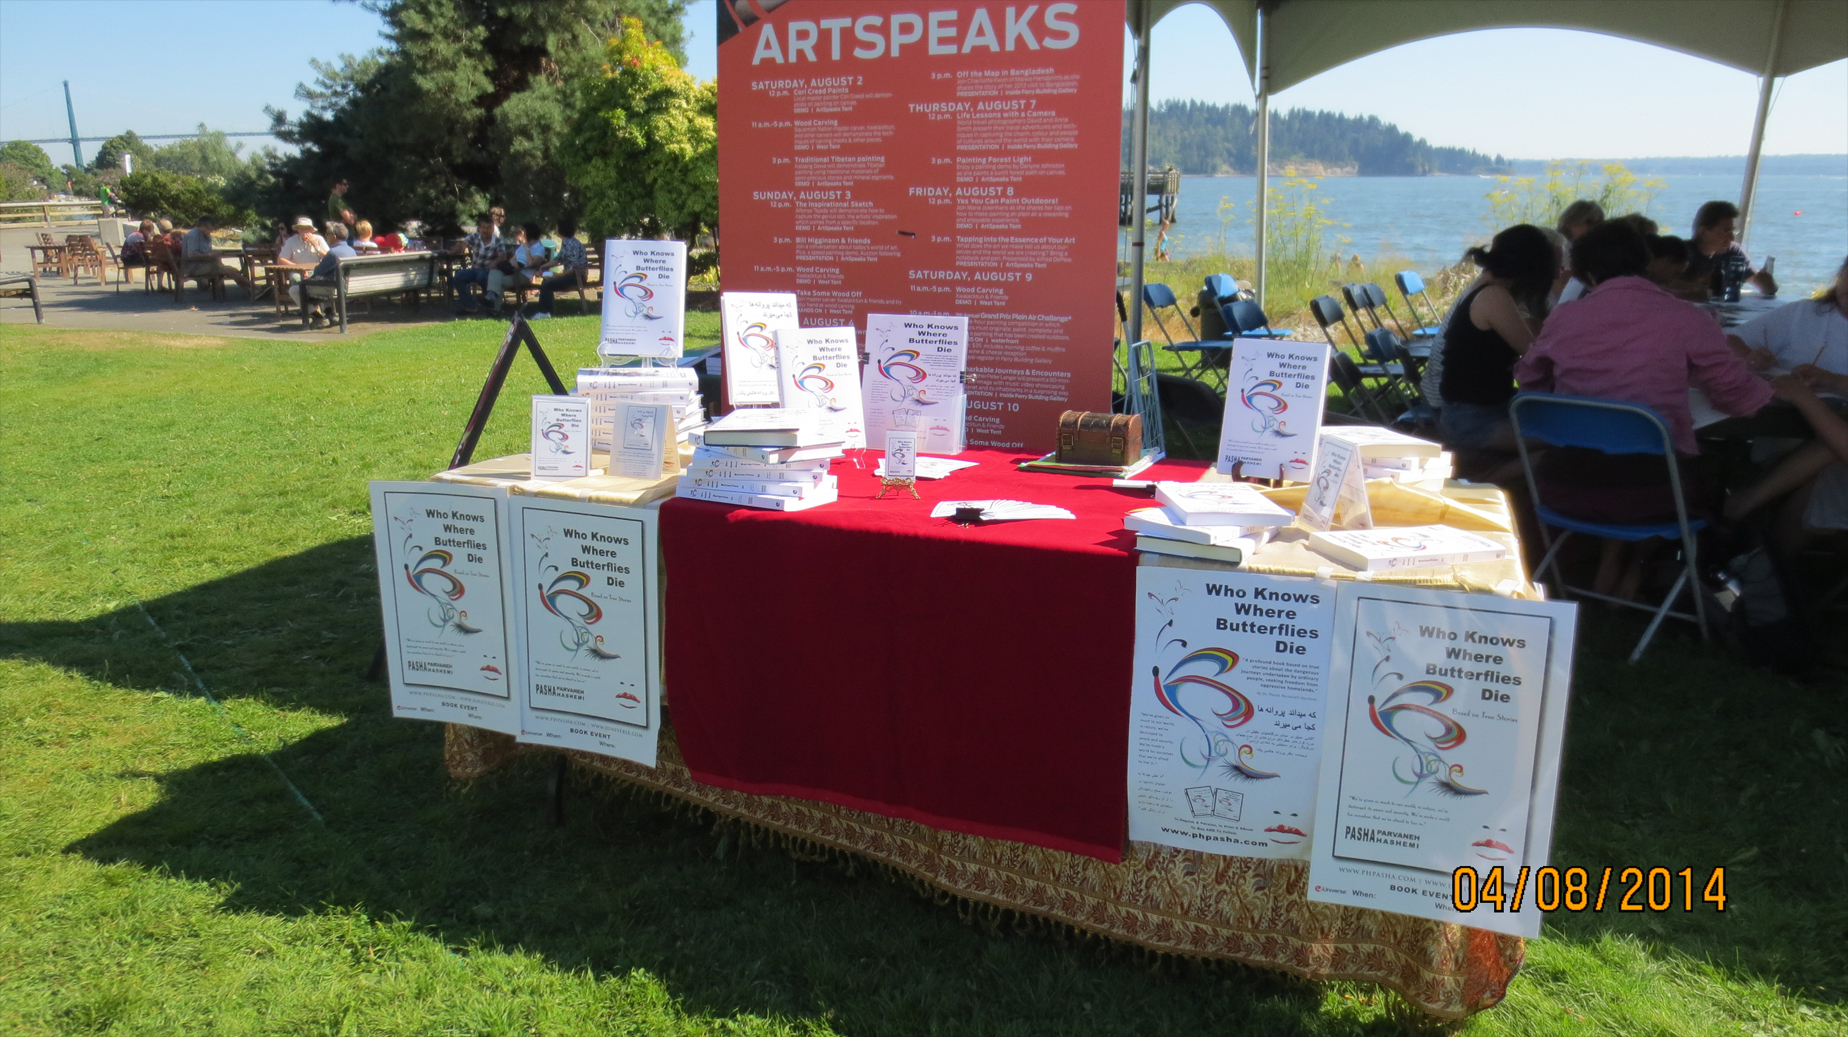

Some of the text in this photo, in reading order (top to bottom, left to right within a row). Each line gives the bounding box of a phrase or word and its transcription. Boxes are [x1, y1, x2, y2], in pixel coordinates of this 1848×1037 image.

[751, 3, 1079, 66] ARTSPEAKS
[1010, 67, 1054, 76] Bangladesh
[752, 76, 863, 90] SATURDAY, AUGUST 2
[909, 100, 1037, 112] THURSDAY, AUGUST 7
[1013, 156, 1032, 164] Light
[753, 191, 851, 200] SUNDAY, AUGUST 3
[909, 187, 1014, 197] FRIDAY, AUGUST 8
[909, 270, 1032, 281] SATURDAY, AUGUST 9
[977, 287, 1003, 295] Carving
[803, 318, 854, 326] AUGUST 4
[995, 368, 1024, 376] Journeys
[1279, 362, 1306, 370] Where
[1269, 371, 1315, 380] Butterflies
[966, 401, 1019, 411] UGUST 10
[426, 509, 484, 522] Who Knows
[443, 524, 475, 535] Where
[563, 529, 629, 545] Who Knows
[435, 537, 487, 550] Butterflies
[581, 545, 617, 558] Where
[467, 554, 483, 563] Die
[571, 558, 630, 574] Butterflies
[607, 577, 625, 587] Die
[1206, 583, 1320, 604] Who Knows
[1235, 603, 1297, 619] Where
[1216, 618, 1319, 639] Butterflies
[1419, 625, 1526, 648] Who Knows
[1275, 641, 1307, 655] Die
[1446, 647, 1503, 664] Where
[408, 661, 427, 671] PASHA
[1426, 663, 1522, 685] Butterflies
[536, 684, 584, 695] PASHA PARVANEH
[1481, 688, 1510, 703] Die
[1452, 708, 1470, 717] Based
[1496, 713, 1518, 723] Stories
[1161, 826, 1268, 847] www.phpasha.com
[1345, 826, 1420, 843] PASHA PARVANEH
[1377, 838, 1419, 849] HASHEMI
[1338, 867, 1417, 883] WWW.PHPASHA.COM
[1352, 890, 1376, 899] When:
[1390, 885, 1418, 895] BOOK
